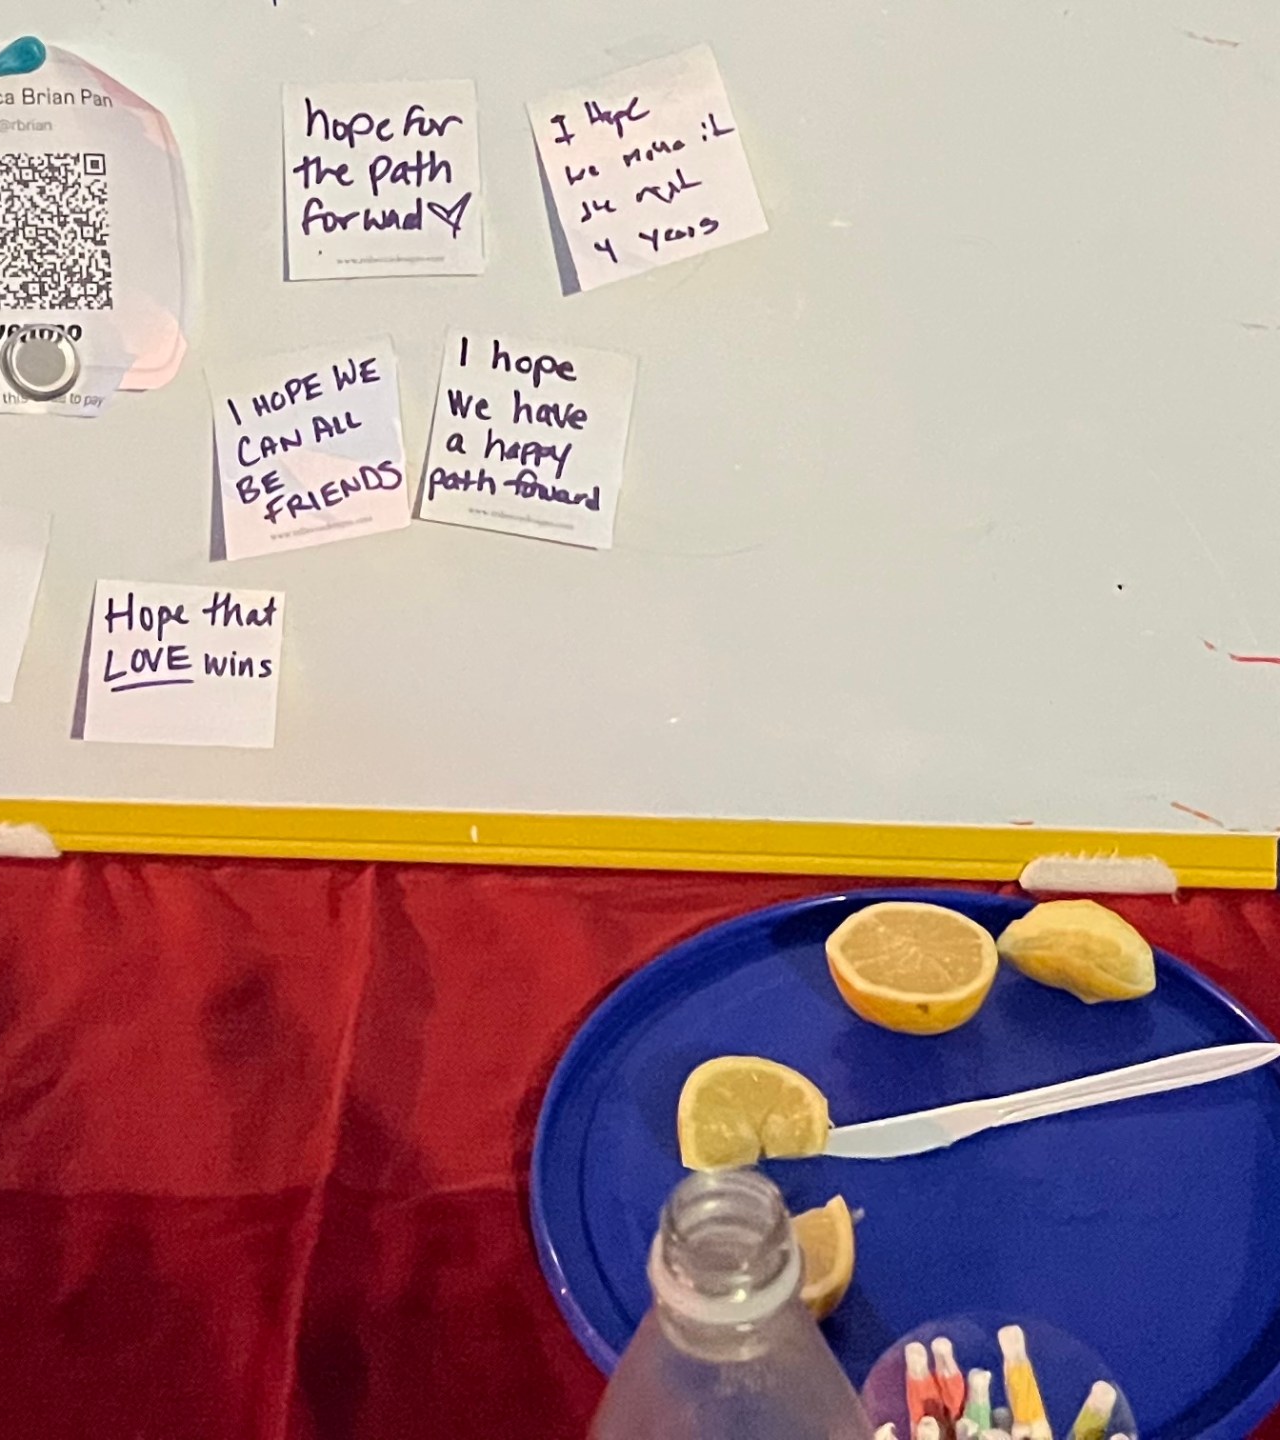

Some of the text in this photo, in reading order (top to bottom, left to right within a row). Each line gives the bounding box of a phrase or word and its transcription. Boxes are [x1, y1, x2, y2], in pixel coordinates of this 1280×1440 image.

[22, 88, 75, 105] Brian
[81, 89, 113, 108] Pan
[305, 97, 463, 148] hope for
[550, 114, 575, 146] I
[293, 150, 452, 197] the path
[460, 336, 577, 388] I hope
[69, 393, 81, 405] to
[83, 394, 104, 408] pay
[227, 357, 380, 425] I HOPE WE
[513, 390, 588, 429] have
[238, 412, 362, 467] CAN ALL
[446, 428, 572, 479] a happy
[236, 470, 285, 504] BE
[264, 460, 402, 524] FRIENDS
[428, 467, 496, 501] path
[105, 592, 277, 641] Hope that
[103, 645, 272, 683] LOVE wins
